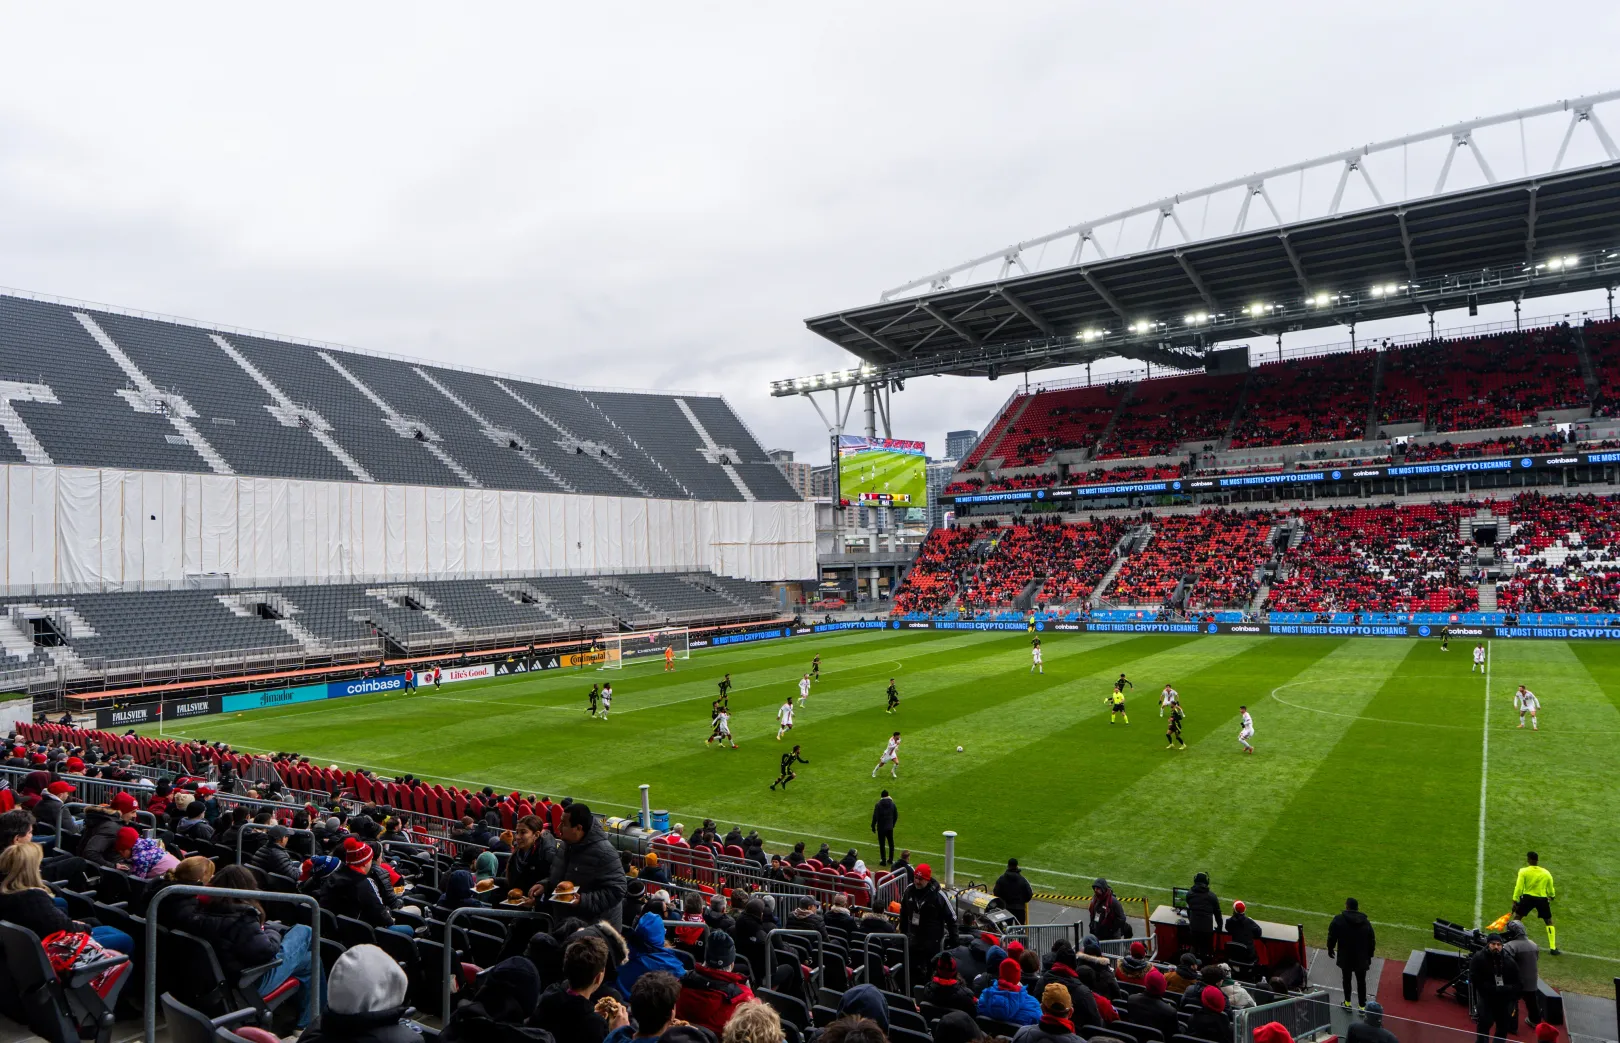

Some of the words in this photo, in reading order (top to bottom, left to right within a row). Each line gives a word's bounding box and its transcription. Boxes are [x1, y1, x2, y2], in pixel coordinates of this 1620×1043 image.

[1601, 453, 1620, 461] MOST
[1441, 463, 1479, 471] CRYPTO
[1480, 461, 1511, 469] EXCHANGE
[1265, 475, 1296, 483] CRYPTO
[1297, 473, 1324, 481] EXCHANGE
[1170, 624, 1199, 632] EXCHANGE
[1300, 626, 1327, 634] TRUSTED
[1328, 626, 1370, 634] CRYPTO
[1372, 626, 1407, 634] EXCHANGE
[1495, 627, 1509, 636] THE
[1510, 628, 1532, 637] MOST
[1533, 628, 1567, 637] TRUSTED
[1569, 628, 1620, 637] CRYPTO
[744, 632, 764, 641] CRYPTO
[764, 630, 781, 639] EXCHANGE
[450, 669, 467, 680] Life's
[469, 667, 489, 677] Good.
[347, 680, 400, 694] coinbase
[176, 701, 208, 713] FALLSVIEW
[112, 709, 147, 721] FALLSVIEW
